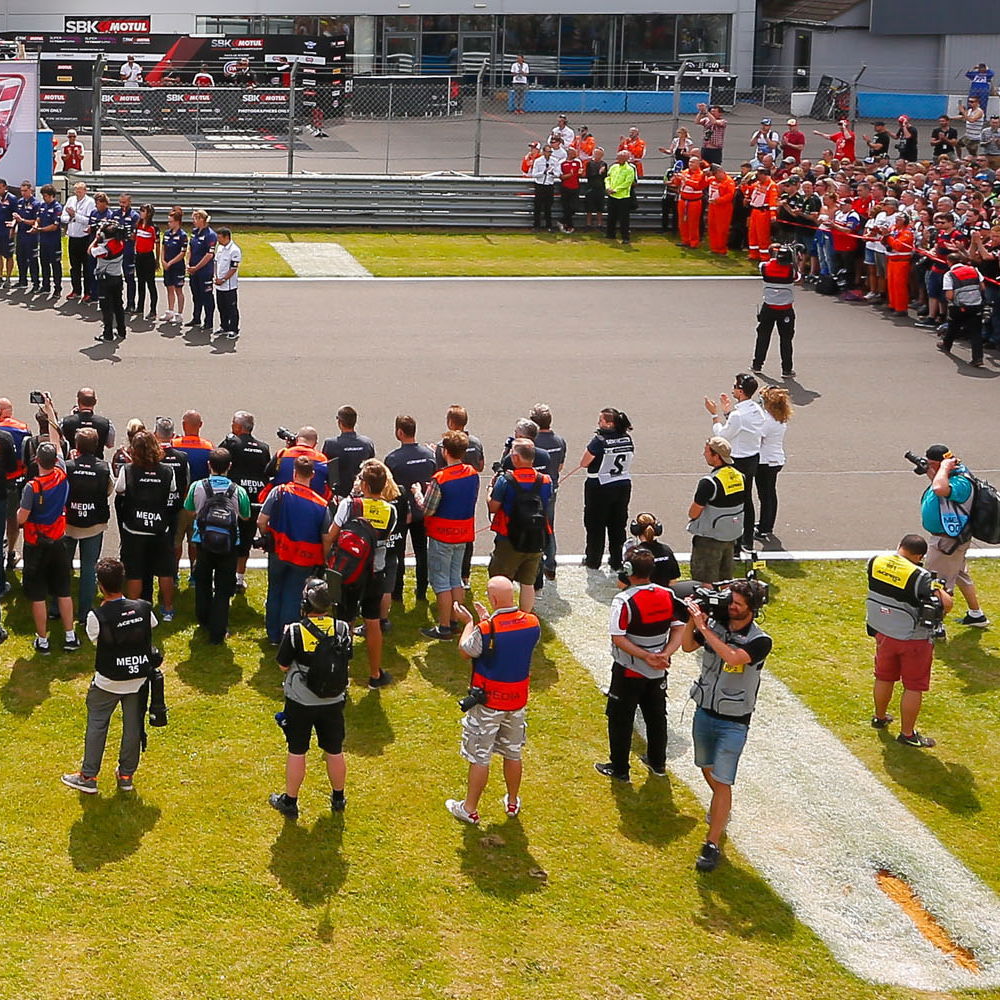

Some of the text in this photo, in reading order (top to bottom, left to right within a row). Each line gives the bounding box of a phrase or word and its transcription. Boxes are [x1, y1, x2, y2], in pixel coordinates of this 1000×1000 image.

[65, 20, 148, 34] SBK MOTUL
[211, 39, 232, 48] SBK
[101, 94, 114, 102] BK
[166, 94, 185, 102] SBK
[242, 94, 260, 102] SBK
[240, 480, 265, 488] MEDIA
[169, 492, 179, 500] DIA
[70, 502, 96, 511] MEDIA
[136, 510, 162, 521] MEDIA
[390, 533, 403, 542] DIA
[116, 654, 149, 667] MEDIA
[128, 665, 140, 674] 35
